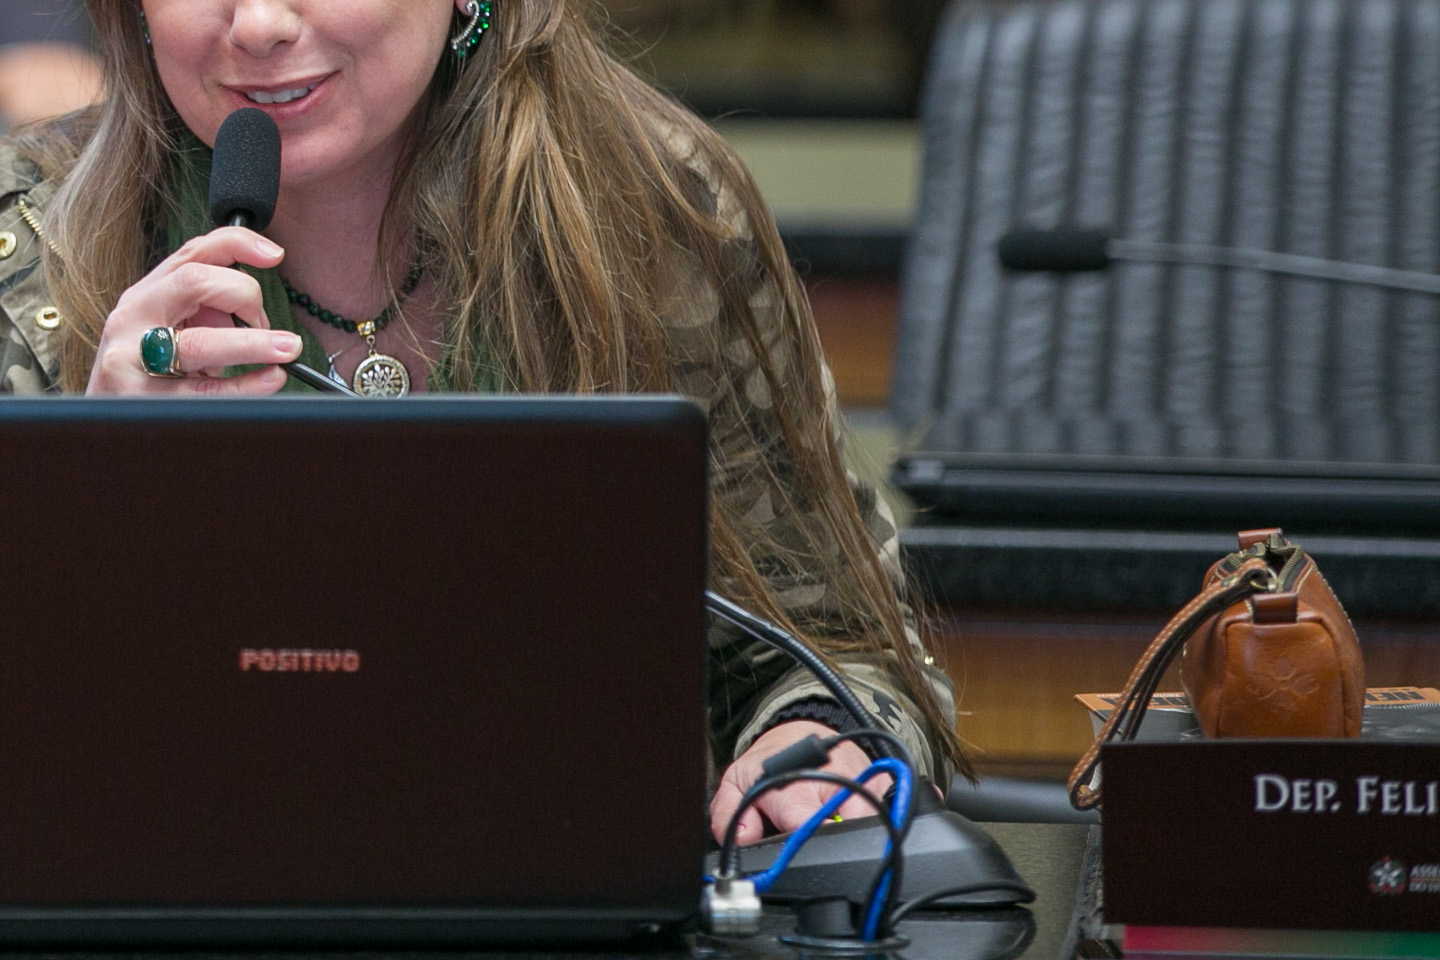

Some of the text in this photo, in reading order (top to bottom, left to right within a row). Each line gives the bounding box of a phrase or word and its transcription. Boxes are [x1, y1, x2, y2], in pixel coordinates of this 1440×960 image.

[238, 649, 360, 672] POSITIVO
[1254, 774, 1440, 815] DEP. FELI
